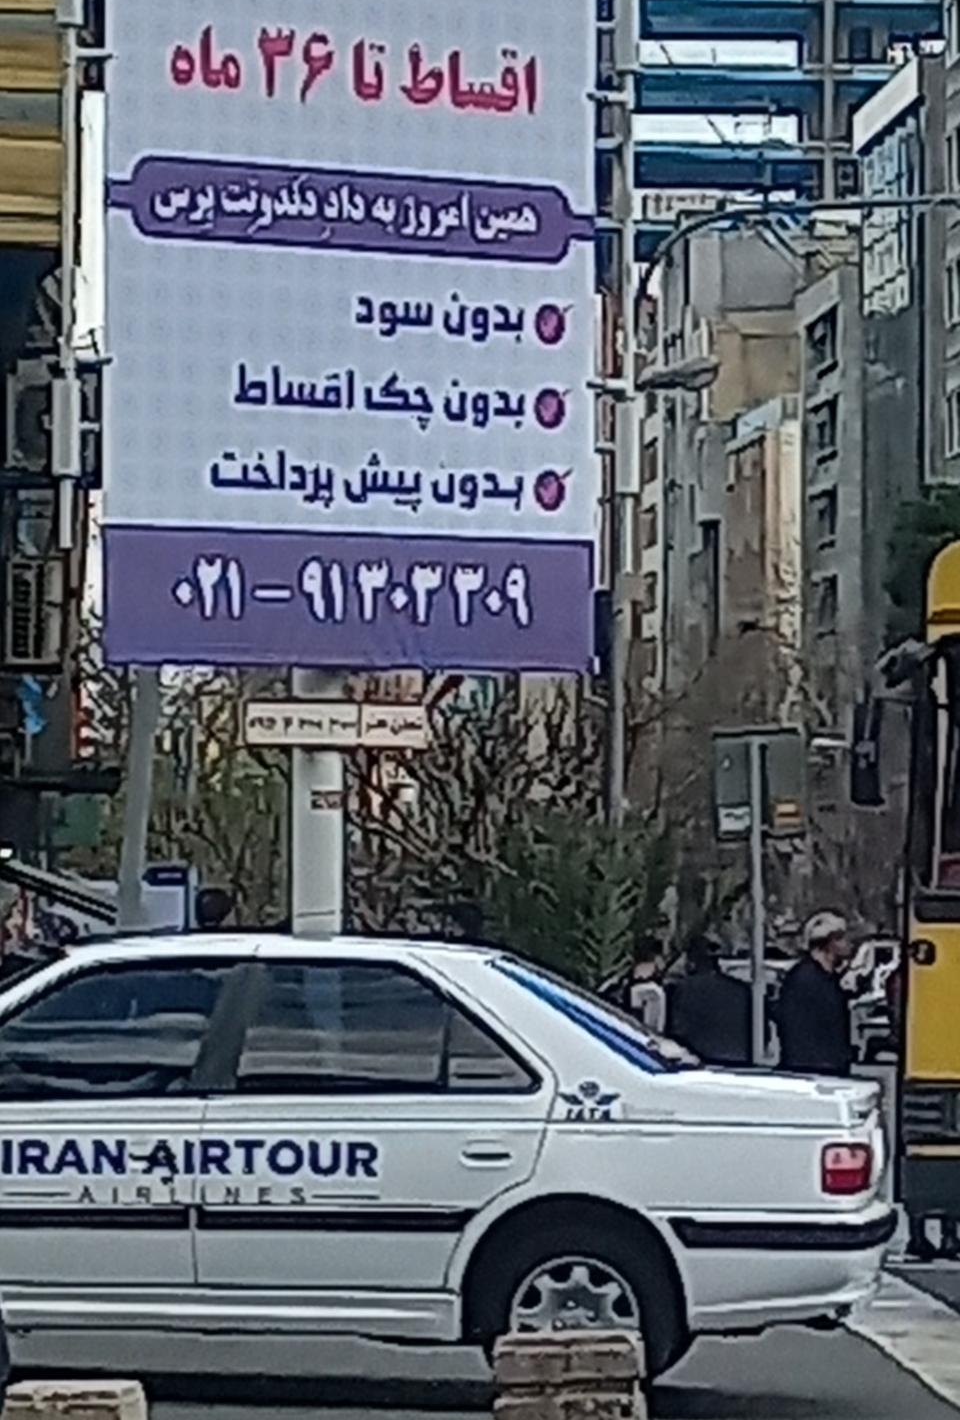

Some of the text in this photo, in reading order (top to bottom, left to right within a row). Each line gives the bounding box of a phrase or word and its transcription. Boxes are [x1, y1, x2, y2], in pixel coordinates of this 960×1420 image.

[170, 26, 537, 114] اقساط تا ۳۶ ماه
[371, 196, 396, 233] به
[402, 190, 472, 237] امروز
[475, 202, 538, 240] همین
[356, 292, 525, 342] بدون سود
[234, 364, 526, 430] بدون چک اقساط
[211, 449, 524, 511] بدون پیش پرداخت
[2, 1139, 379, 1177] IRAN AIRTOUR
